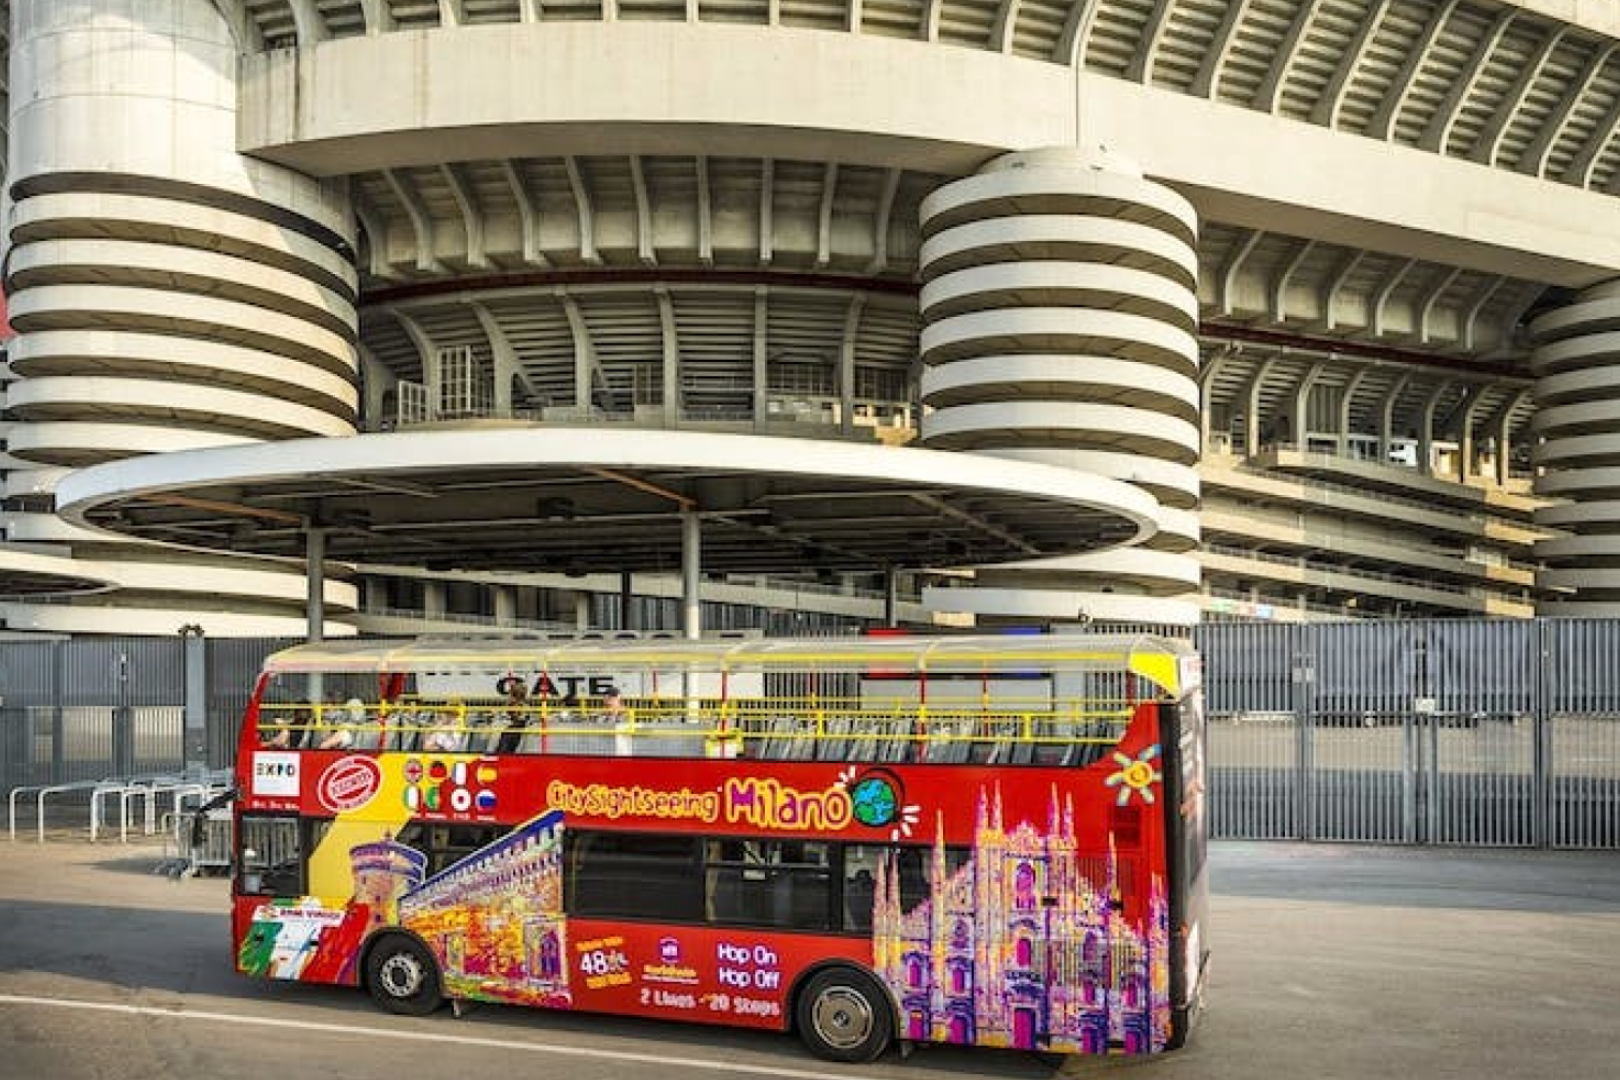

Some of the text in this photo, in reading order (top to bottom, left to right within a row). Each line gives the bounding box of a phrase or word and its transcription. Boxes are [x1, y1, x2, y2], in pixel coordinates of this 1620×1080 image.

[256, 763, 295, 776] EXPO
[726, 778, 850, 828] Milano
[717, 943, 778, 965] Hop On
[719, 967, 750, 988] Hop
[754, 970, 780, 988] Off
